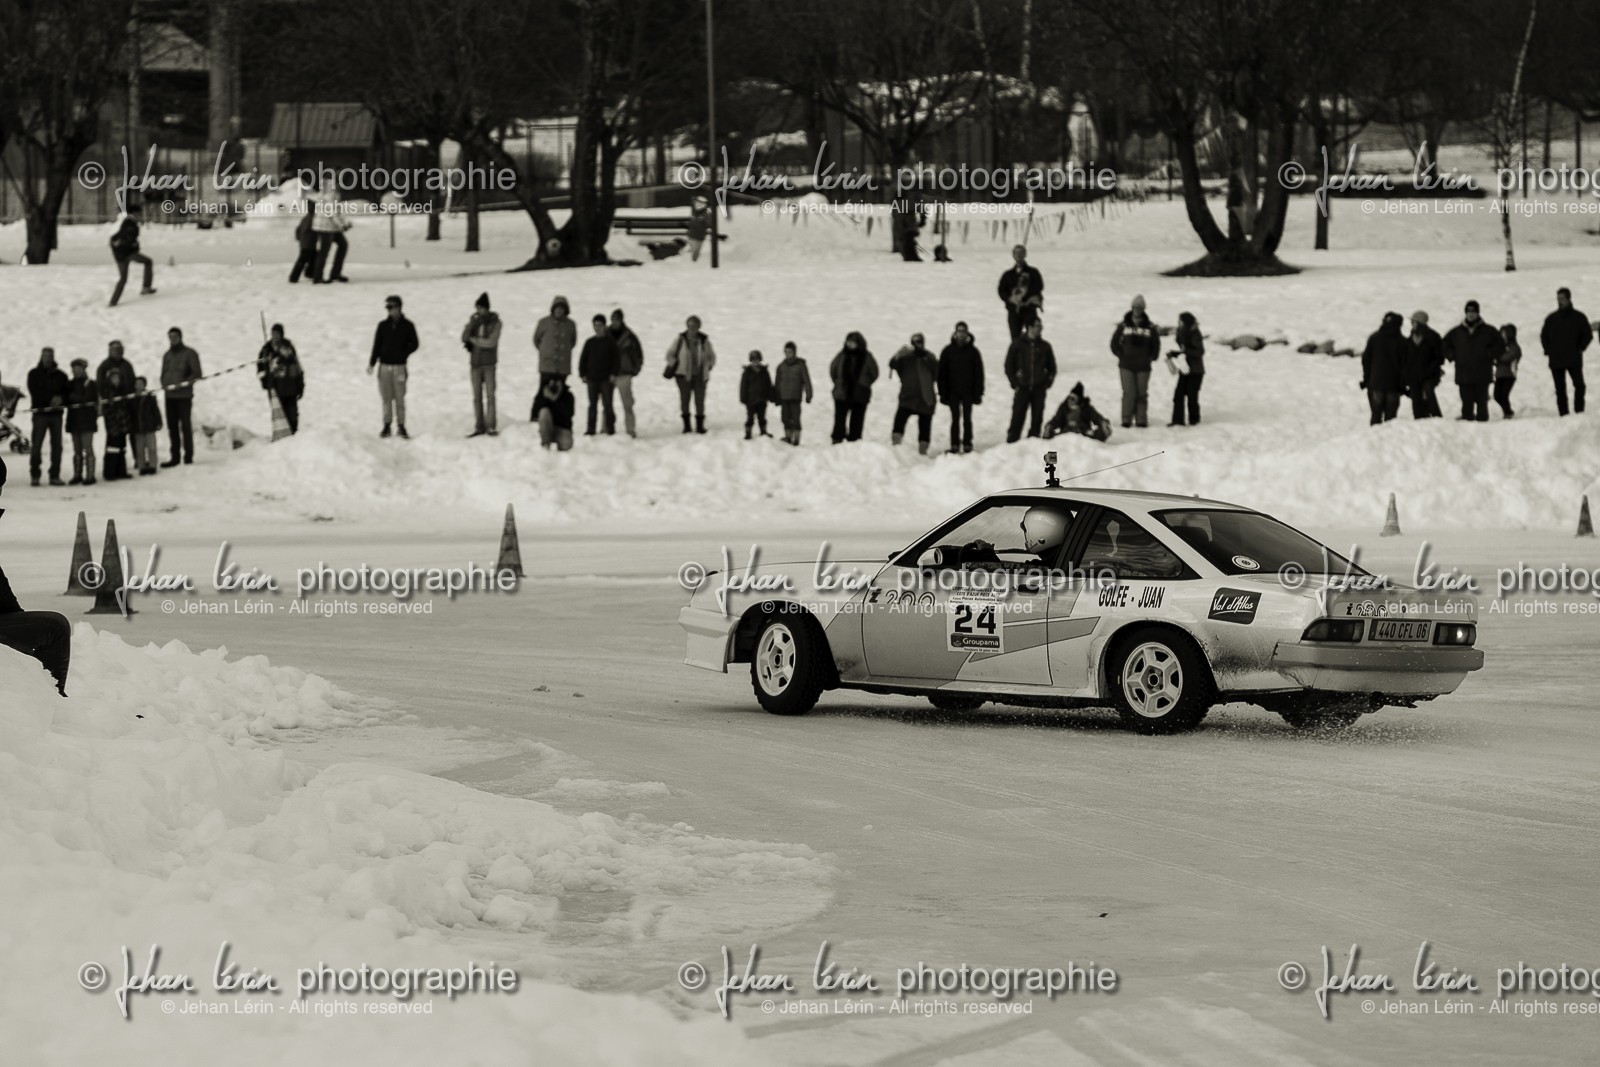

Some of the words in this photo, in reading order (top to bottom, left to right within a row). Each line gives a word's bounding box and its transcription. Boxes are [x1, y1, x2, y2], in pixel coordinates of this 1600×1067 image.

[1099, 586, 1129, 607] GOLFE
[1138, 586, 1166, 608] JUAN
[1213, 594, 1227, 610] Val
[954, 604, 996, 634] 24
[1379, 622, 1396, 638] 440
[1398, 622, 1414, 638] CFL
[1416, 622, 1428, 638] 06
[962, 638, 999, 646] Groupama
